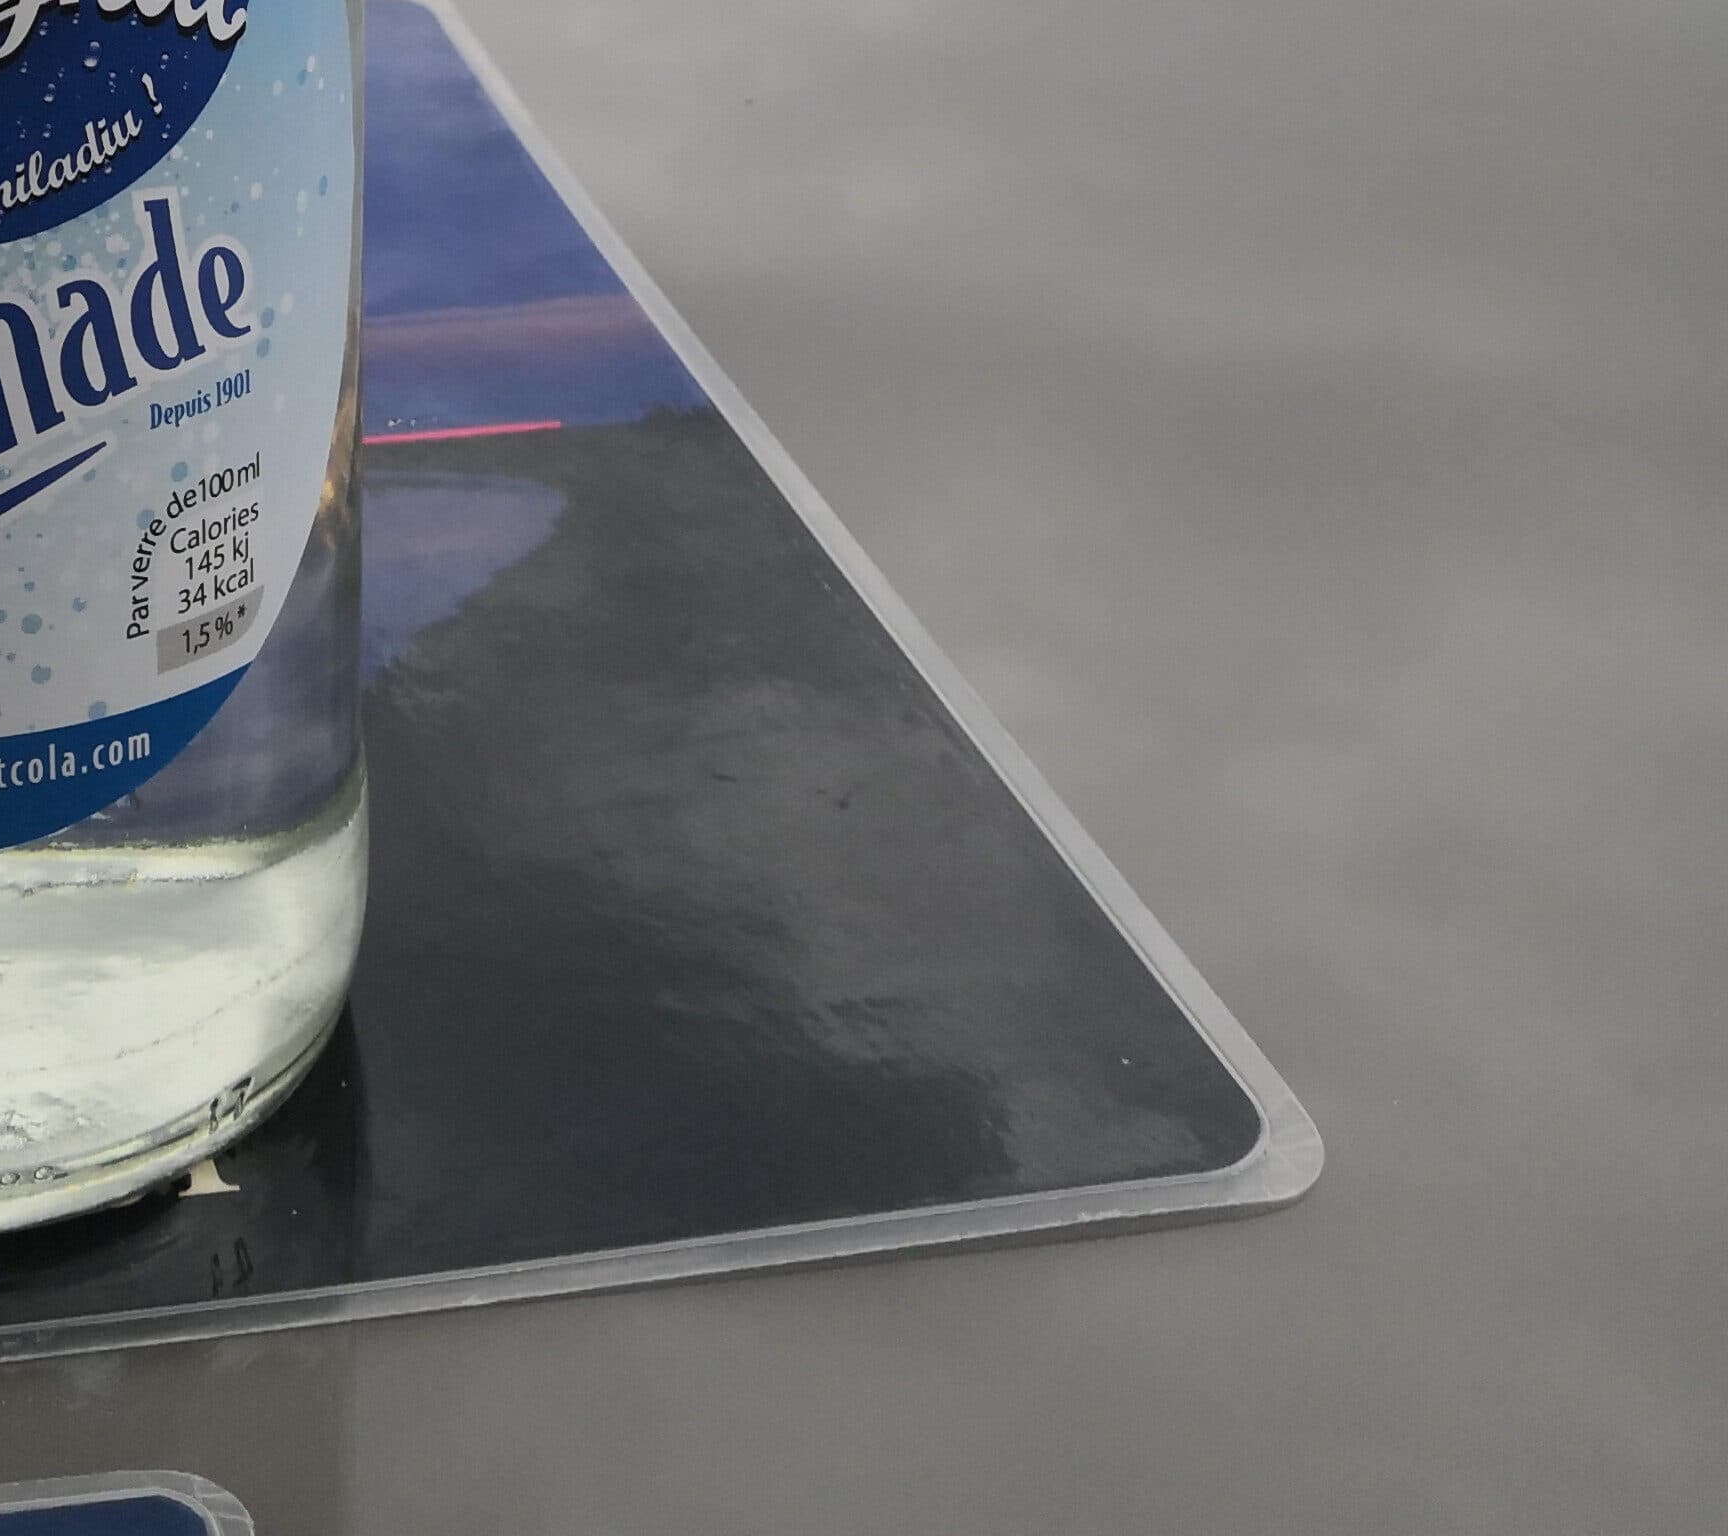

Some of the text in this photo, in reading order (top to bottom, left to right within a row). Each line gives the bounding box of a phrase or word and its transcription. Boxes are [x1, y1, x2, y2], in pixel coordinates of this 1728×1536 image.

[149, 369, 252, 429] Depuis 1901
[131, 518, 167, 591] verre
[170, 501, 259, 554] Calories
[178, 557, 254, 614] 34 kcal
[185, 543, 225, 580] 145
[126, 595, 150, 640] Par
